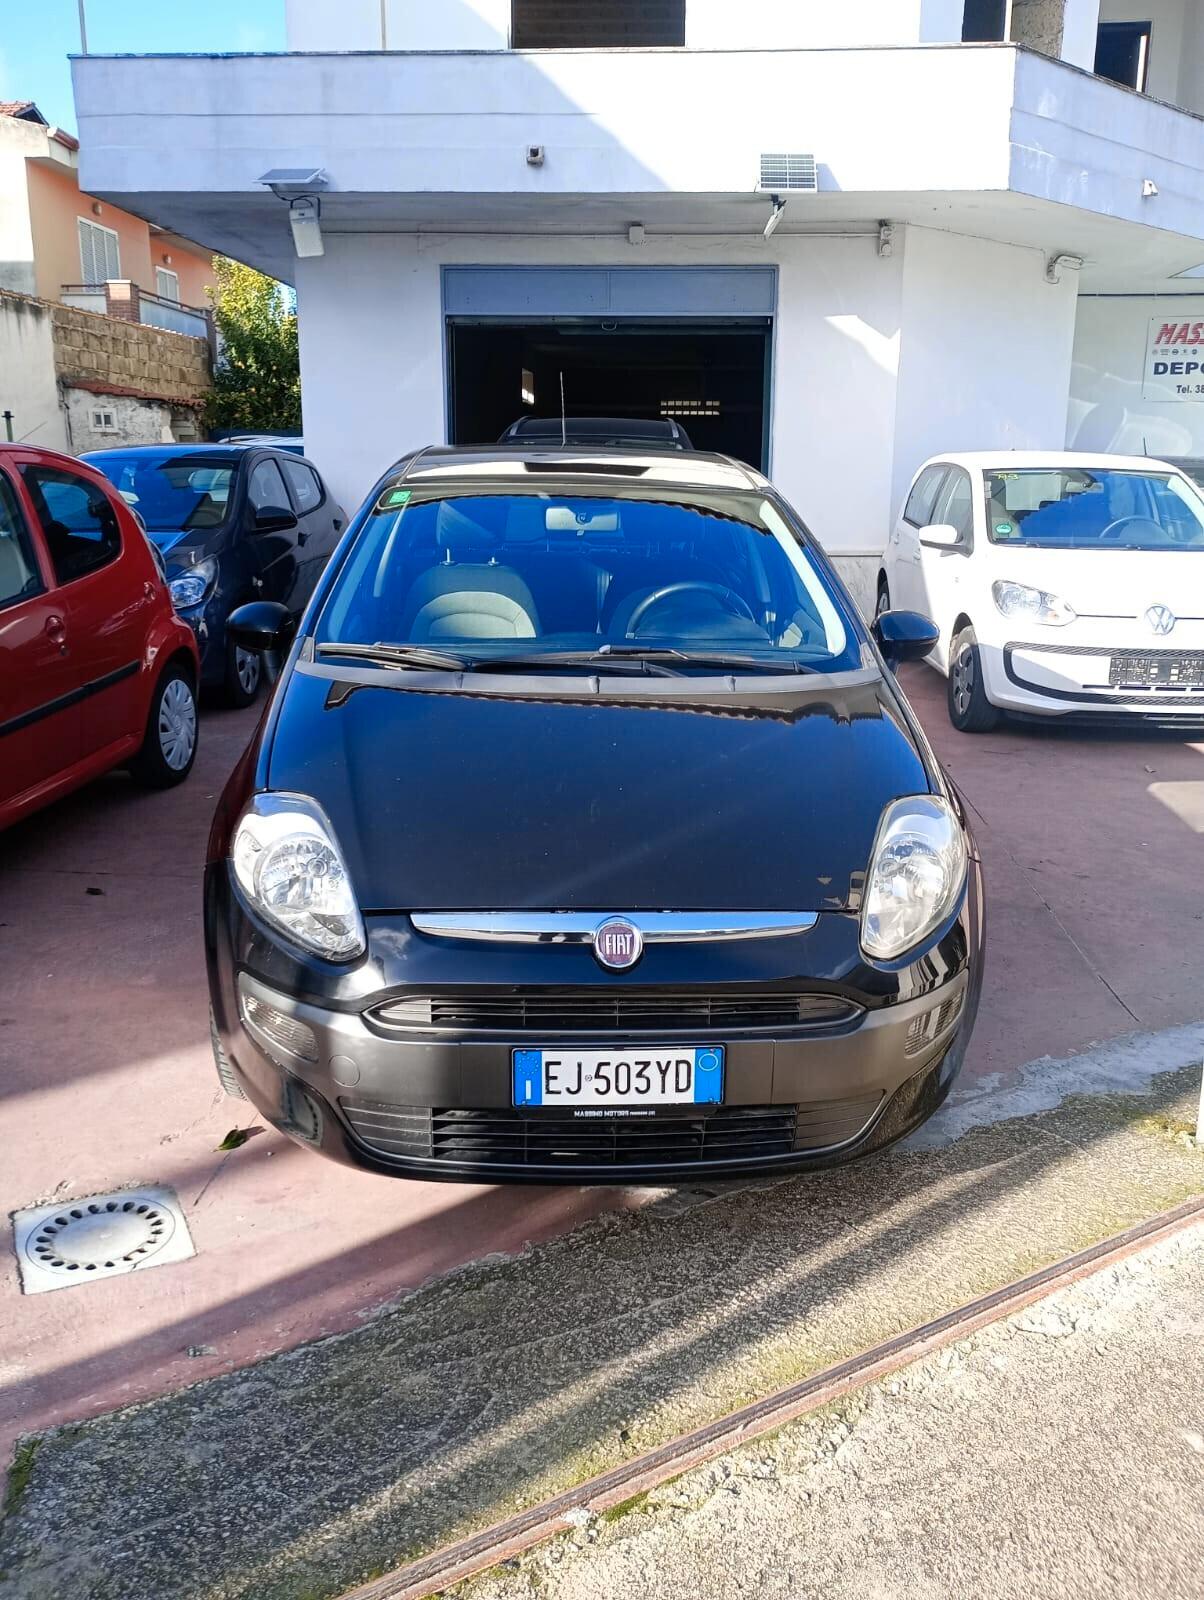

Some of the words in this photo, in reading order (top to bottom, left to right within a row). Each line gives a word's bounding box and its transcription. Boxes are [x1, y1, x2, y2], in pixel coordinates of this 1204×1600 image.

[1155, 323, 1204, 345] MAS
[1153, 362, 1204, 375] DEP
[1176, 384, 1192, 393] Tel.
[605, 933, 632, 955] FIAT
